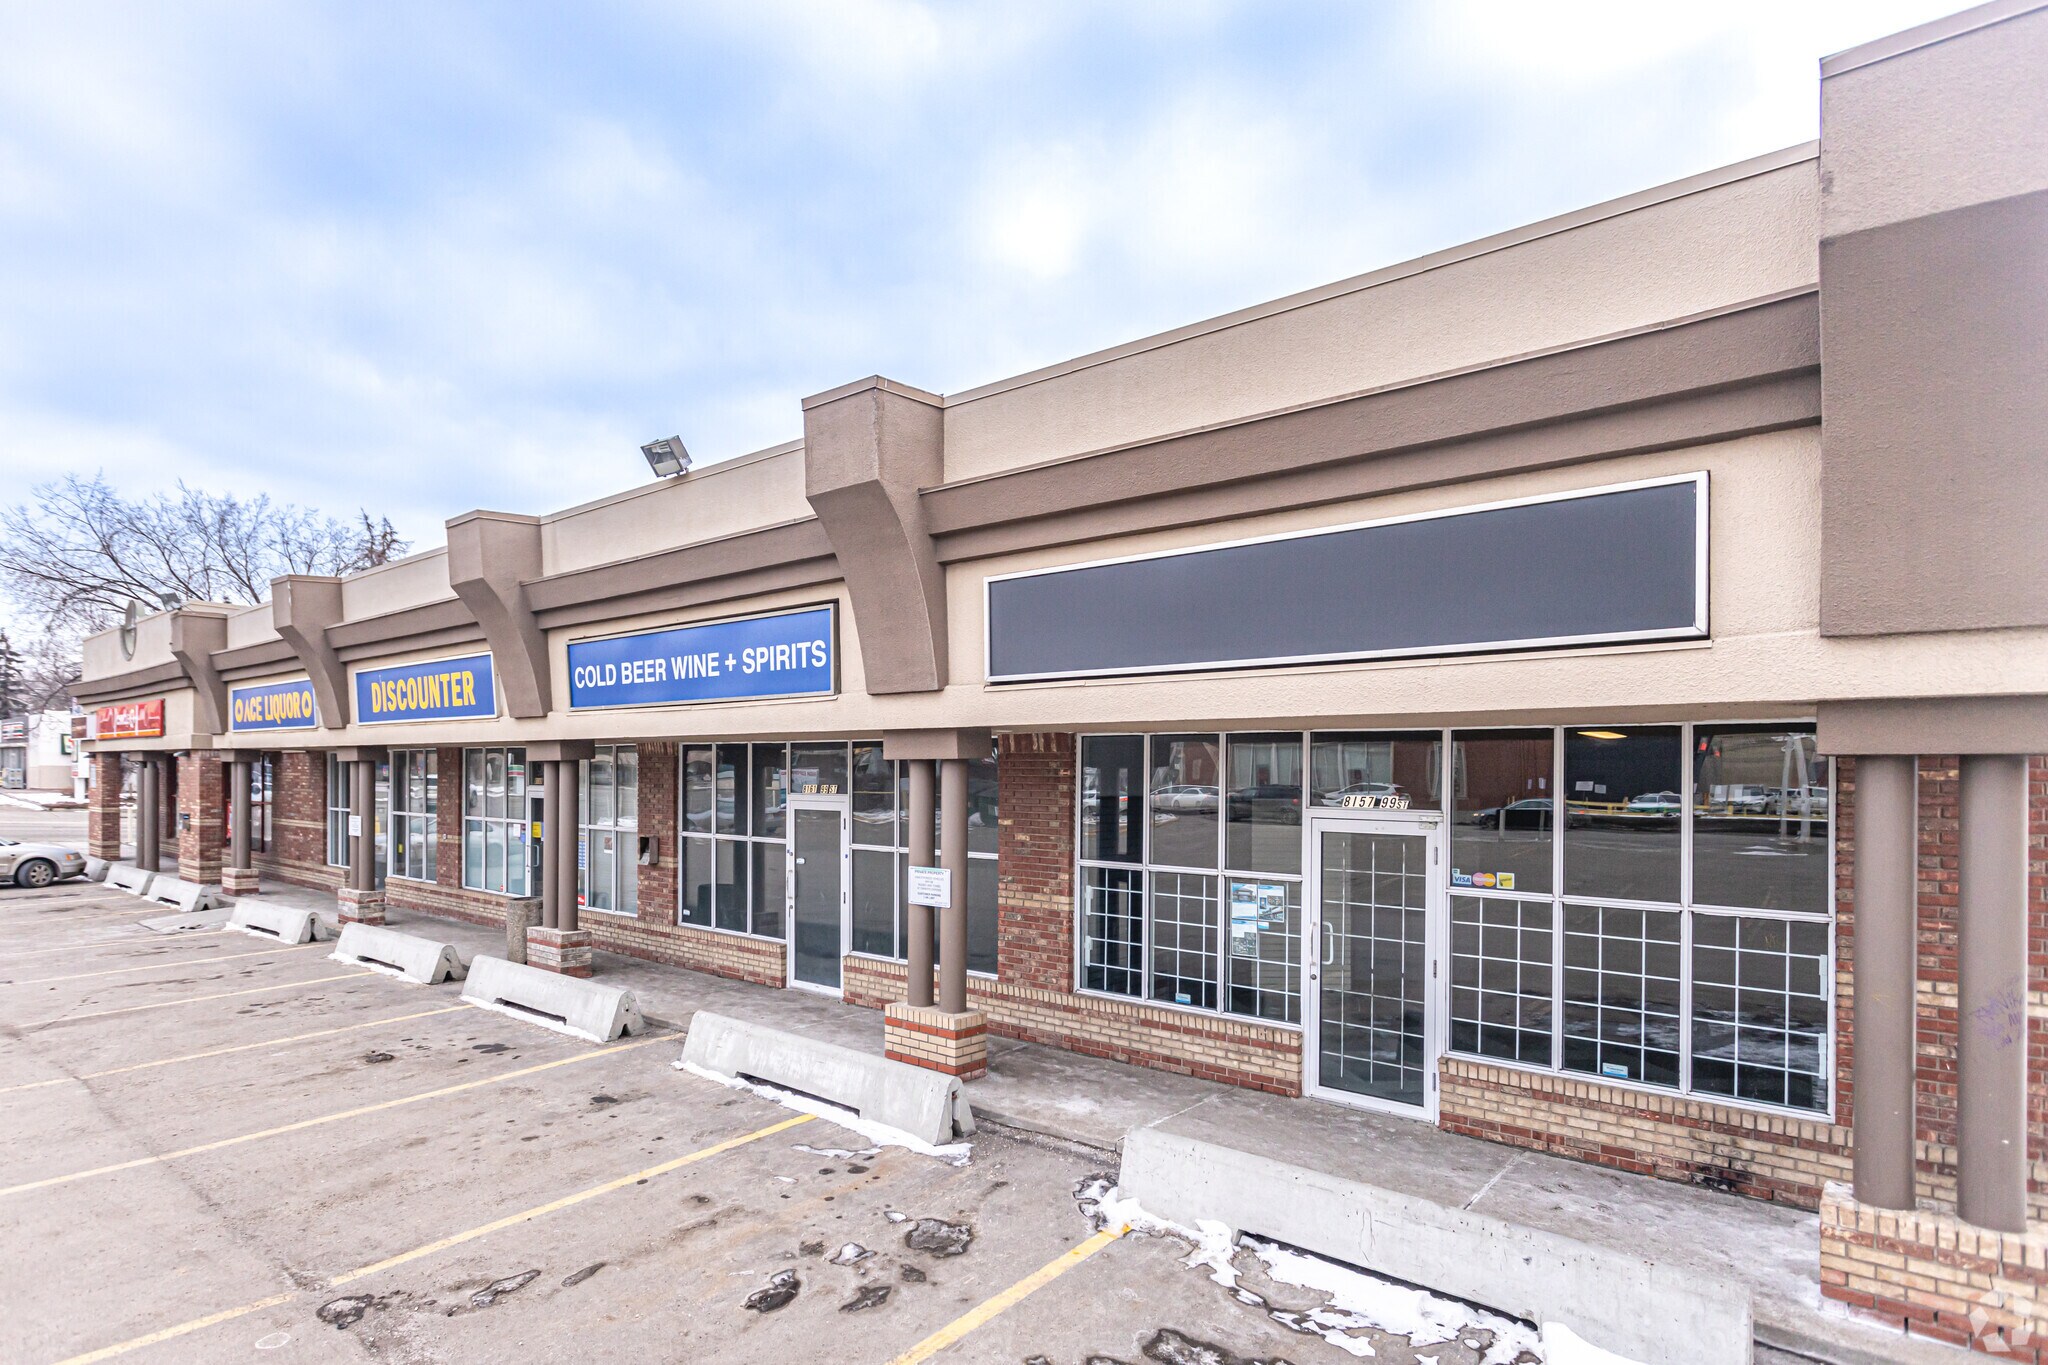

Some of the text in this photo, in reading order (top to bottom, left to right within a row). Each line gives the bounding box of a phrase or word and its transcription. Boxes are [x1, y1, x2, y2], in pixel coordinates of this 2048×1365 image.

[574, 639, 827, 689] COLD BEER WINE + SPIRITS
[371, 670, 476, 713] DISCOUNTER
[1343, 796, 1375, 807] 8157
